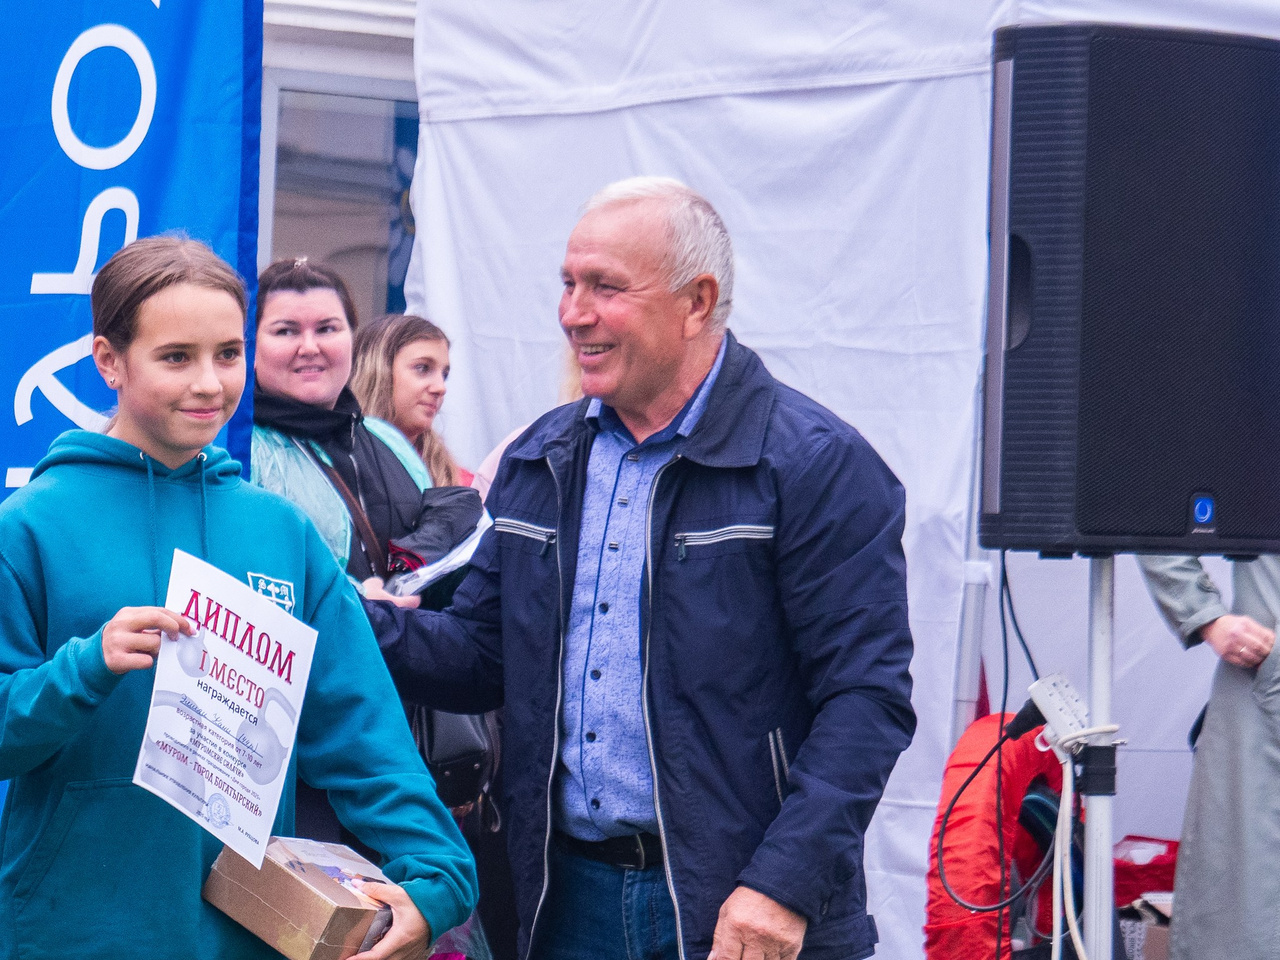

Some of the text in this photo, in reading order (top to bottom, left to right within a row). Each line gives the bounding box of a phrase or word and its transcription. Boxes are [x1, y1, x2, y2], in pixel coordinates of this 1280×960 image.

[181, 588, 296, 685] ДИПЛОМ
[197, 679, 258, 726] награждается
[199, 650, 208, 671] I
[209, 656, 265, 709] МЕСТО
[155, 739, 188, 766] «МУРОМ
[193, 761, 214, 784] ГОРОД
[214, 776, 262, 817] БОГАТЫРСКИЙ»
